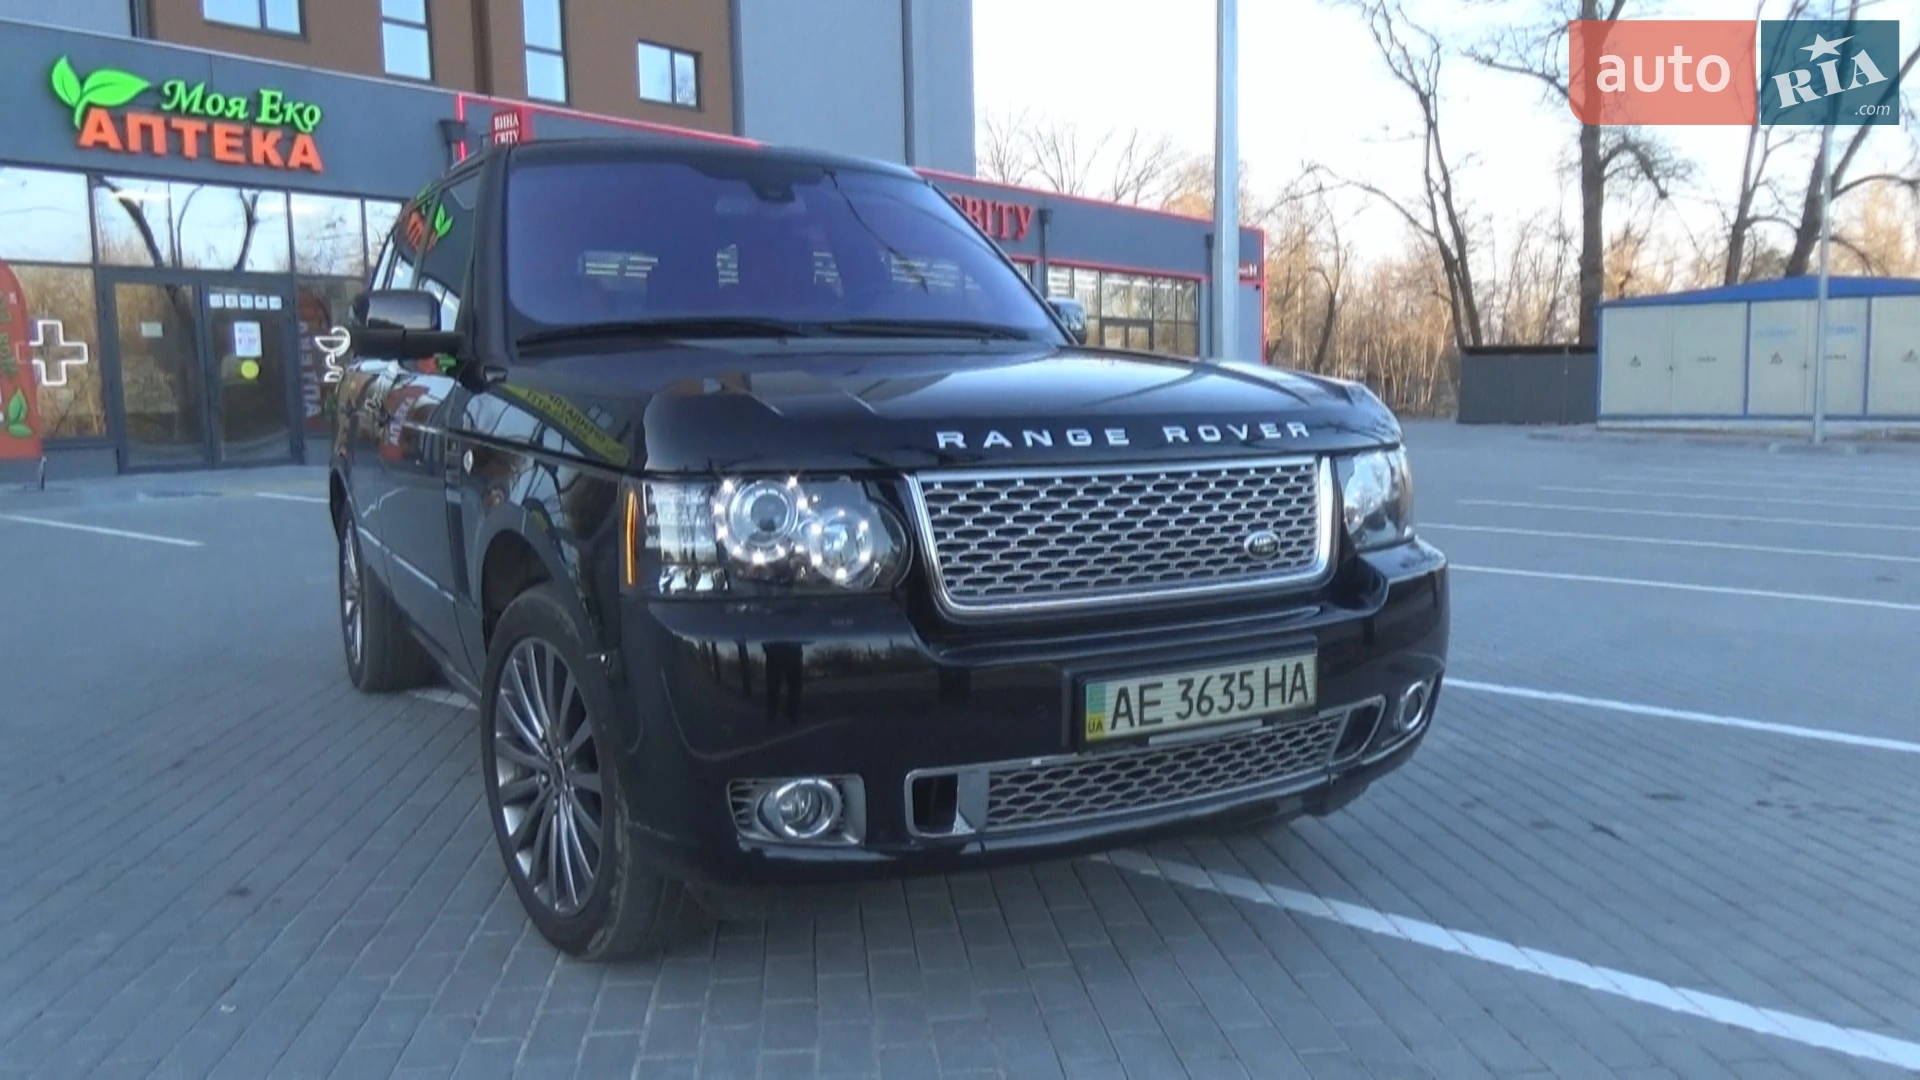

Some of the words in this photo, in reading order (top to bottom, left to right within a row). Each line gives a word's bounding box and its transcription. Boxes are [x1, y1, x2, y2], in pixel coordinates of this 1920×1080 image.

[160, 79, 249, 121] Моя
[255, 88, 322, 134] Еко
[78, 107, 323, 173] АПТЕКА
[935, 428, 1131, 450] RANGE
[1162, 421, 1311, 444] ROVER
[1110, 682, 1164, 731] AE
[1174, 670, 1255, 721] 3635
[1263, 661, 1310, 708] HA
